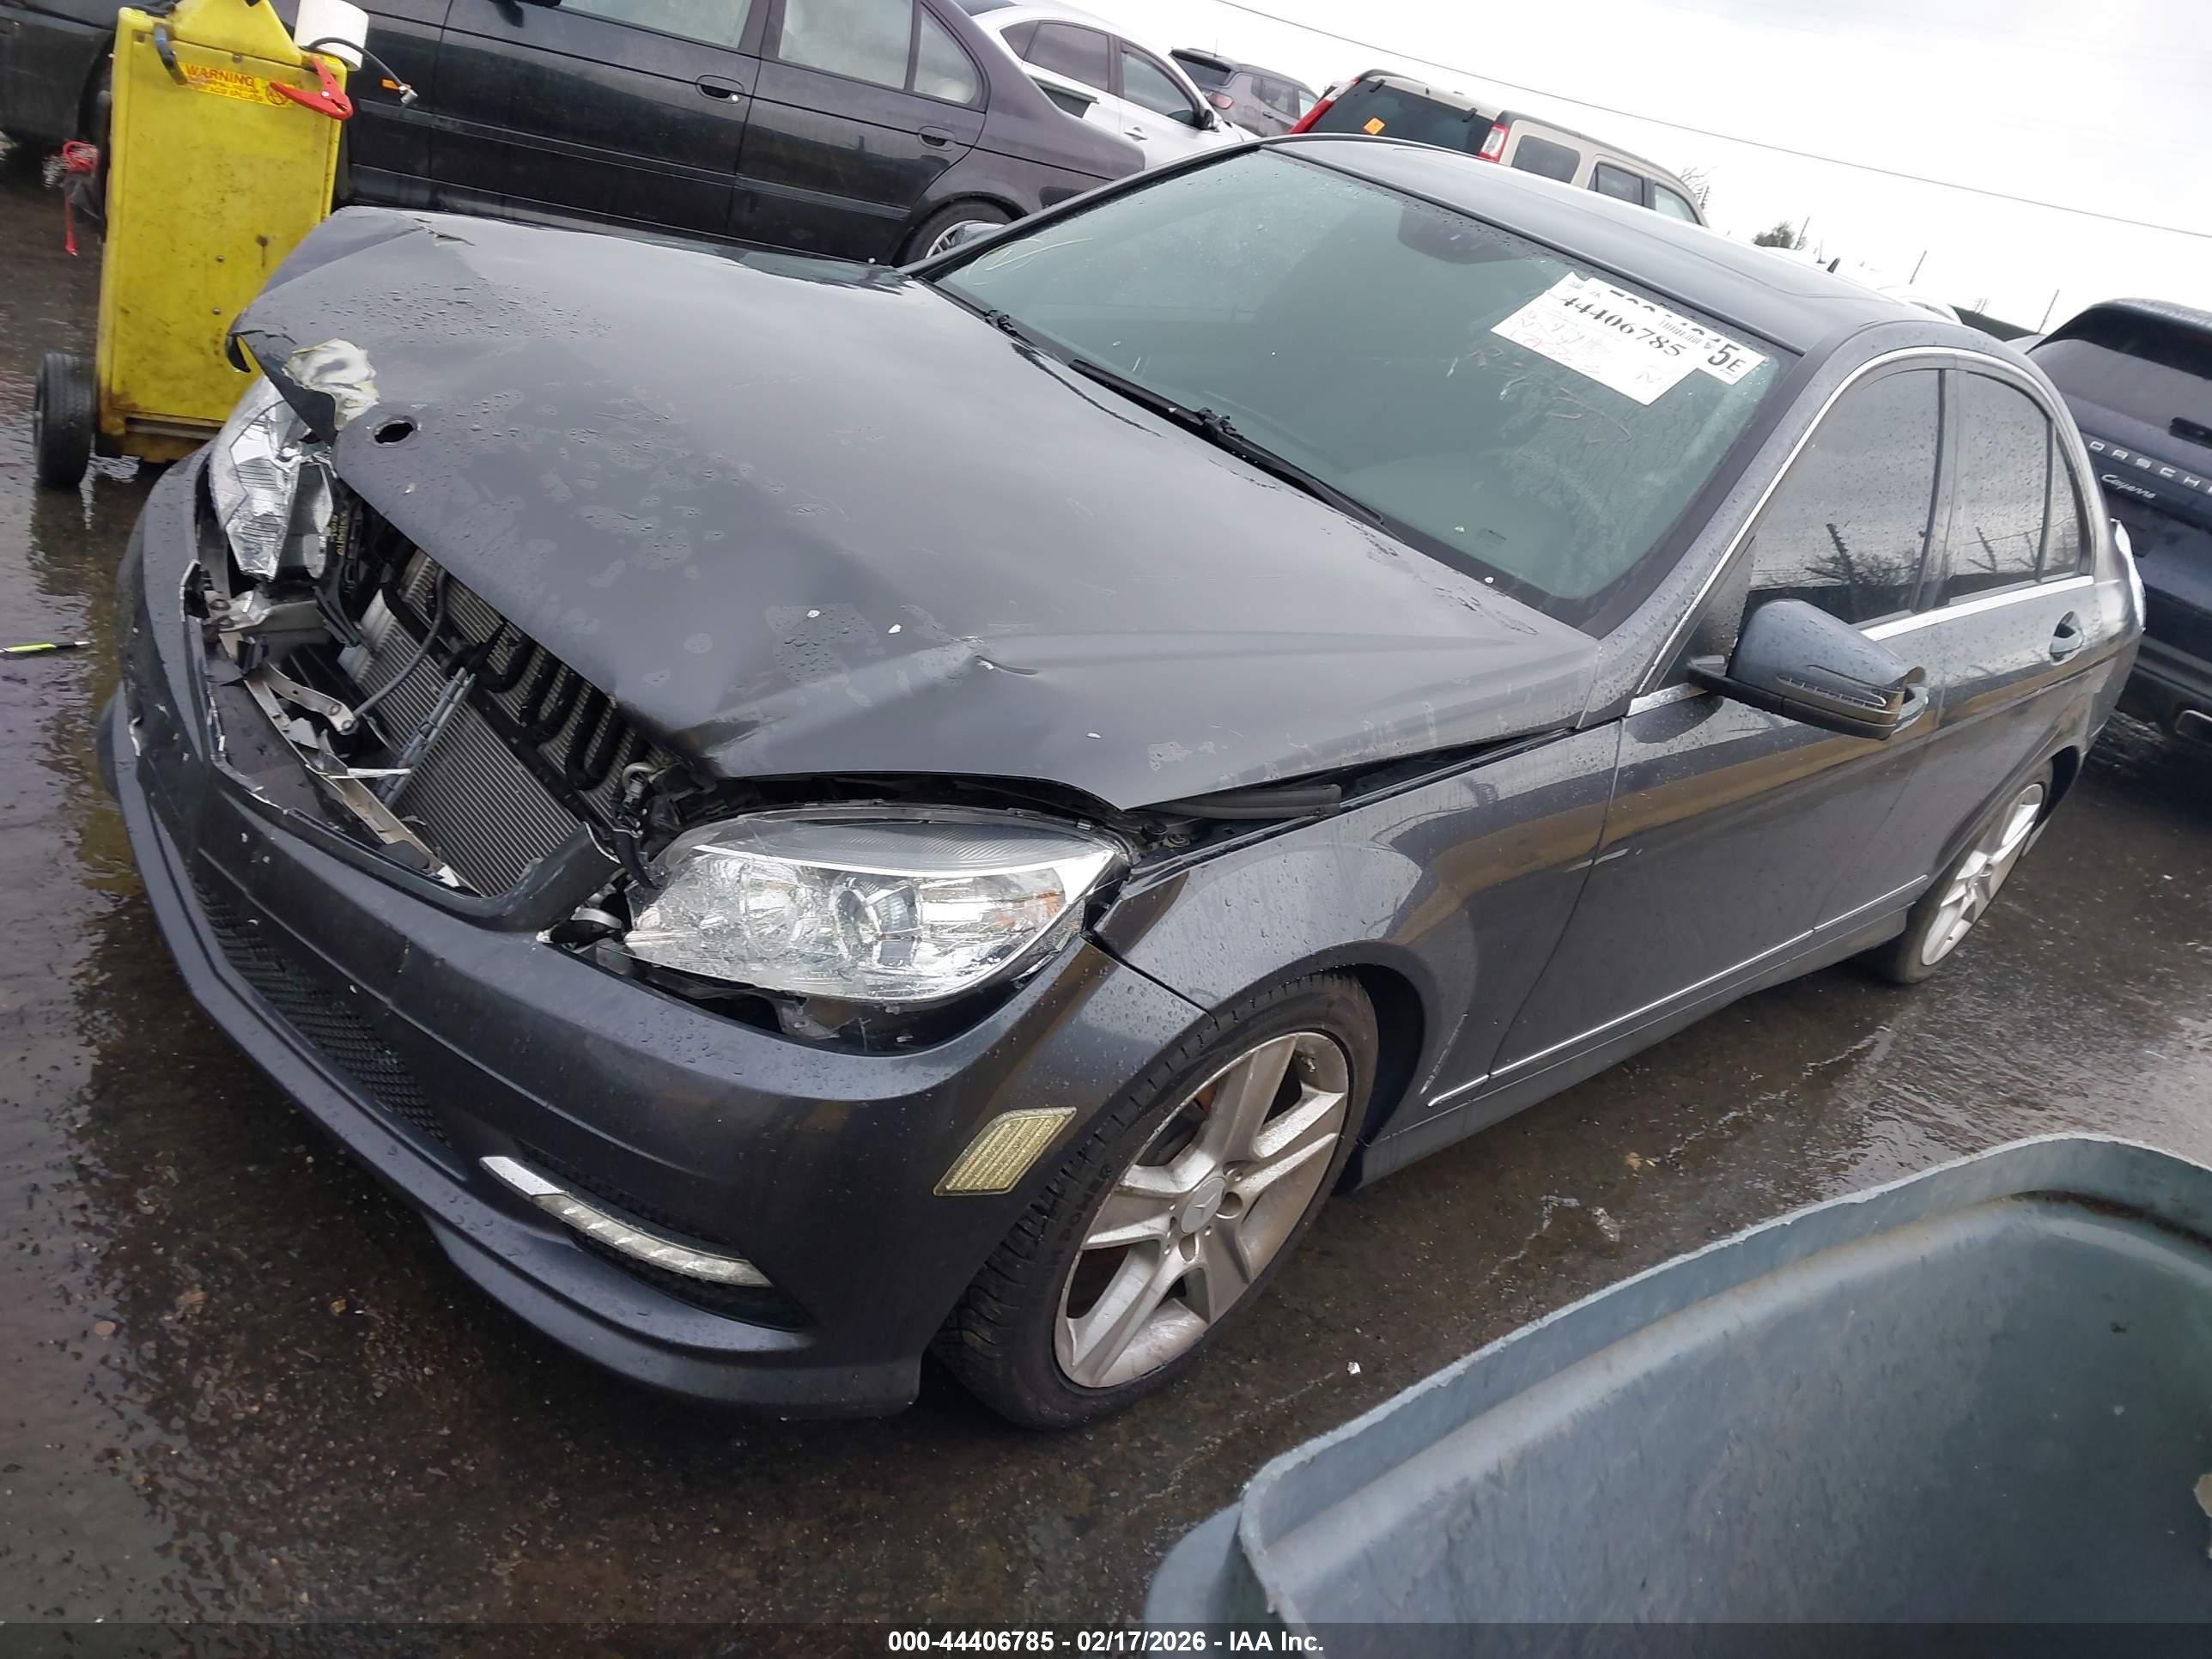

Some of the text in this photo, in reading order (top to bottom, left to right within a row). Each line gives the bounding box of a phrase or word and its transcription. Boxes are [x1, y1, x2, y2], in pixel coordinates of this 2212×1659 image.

[184, 64, 255, 87] WARNING
[1559, 297, 1687, 356] 44406785
[2088, 441, 2212, 495] ORSCH
[2100, 474, 2157, 500] Cayenne
